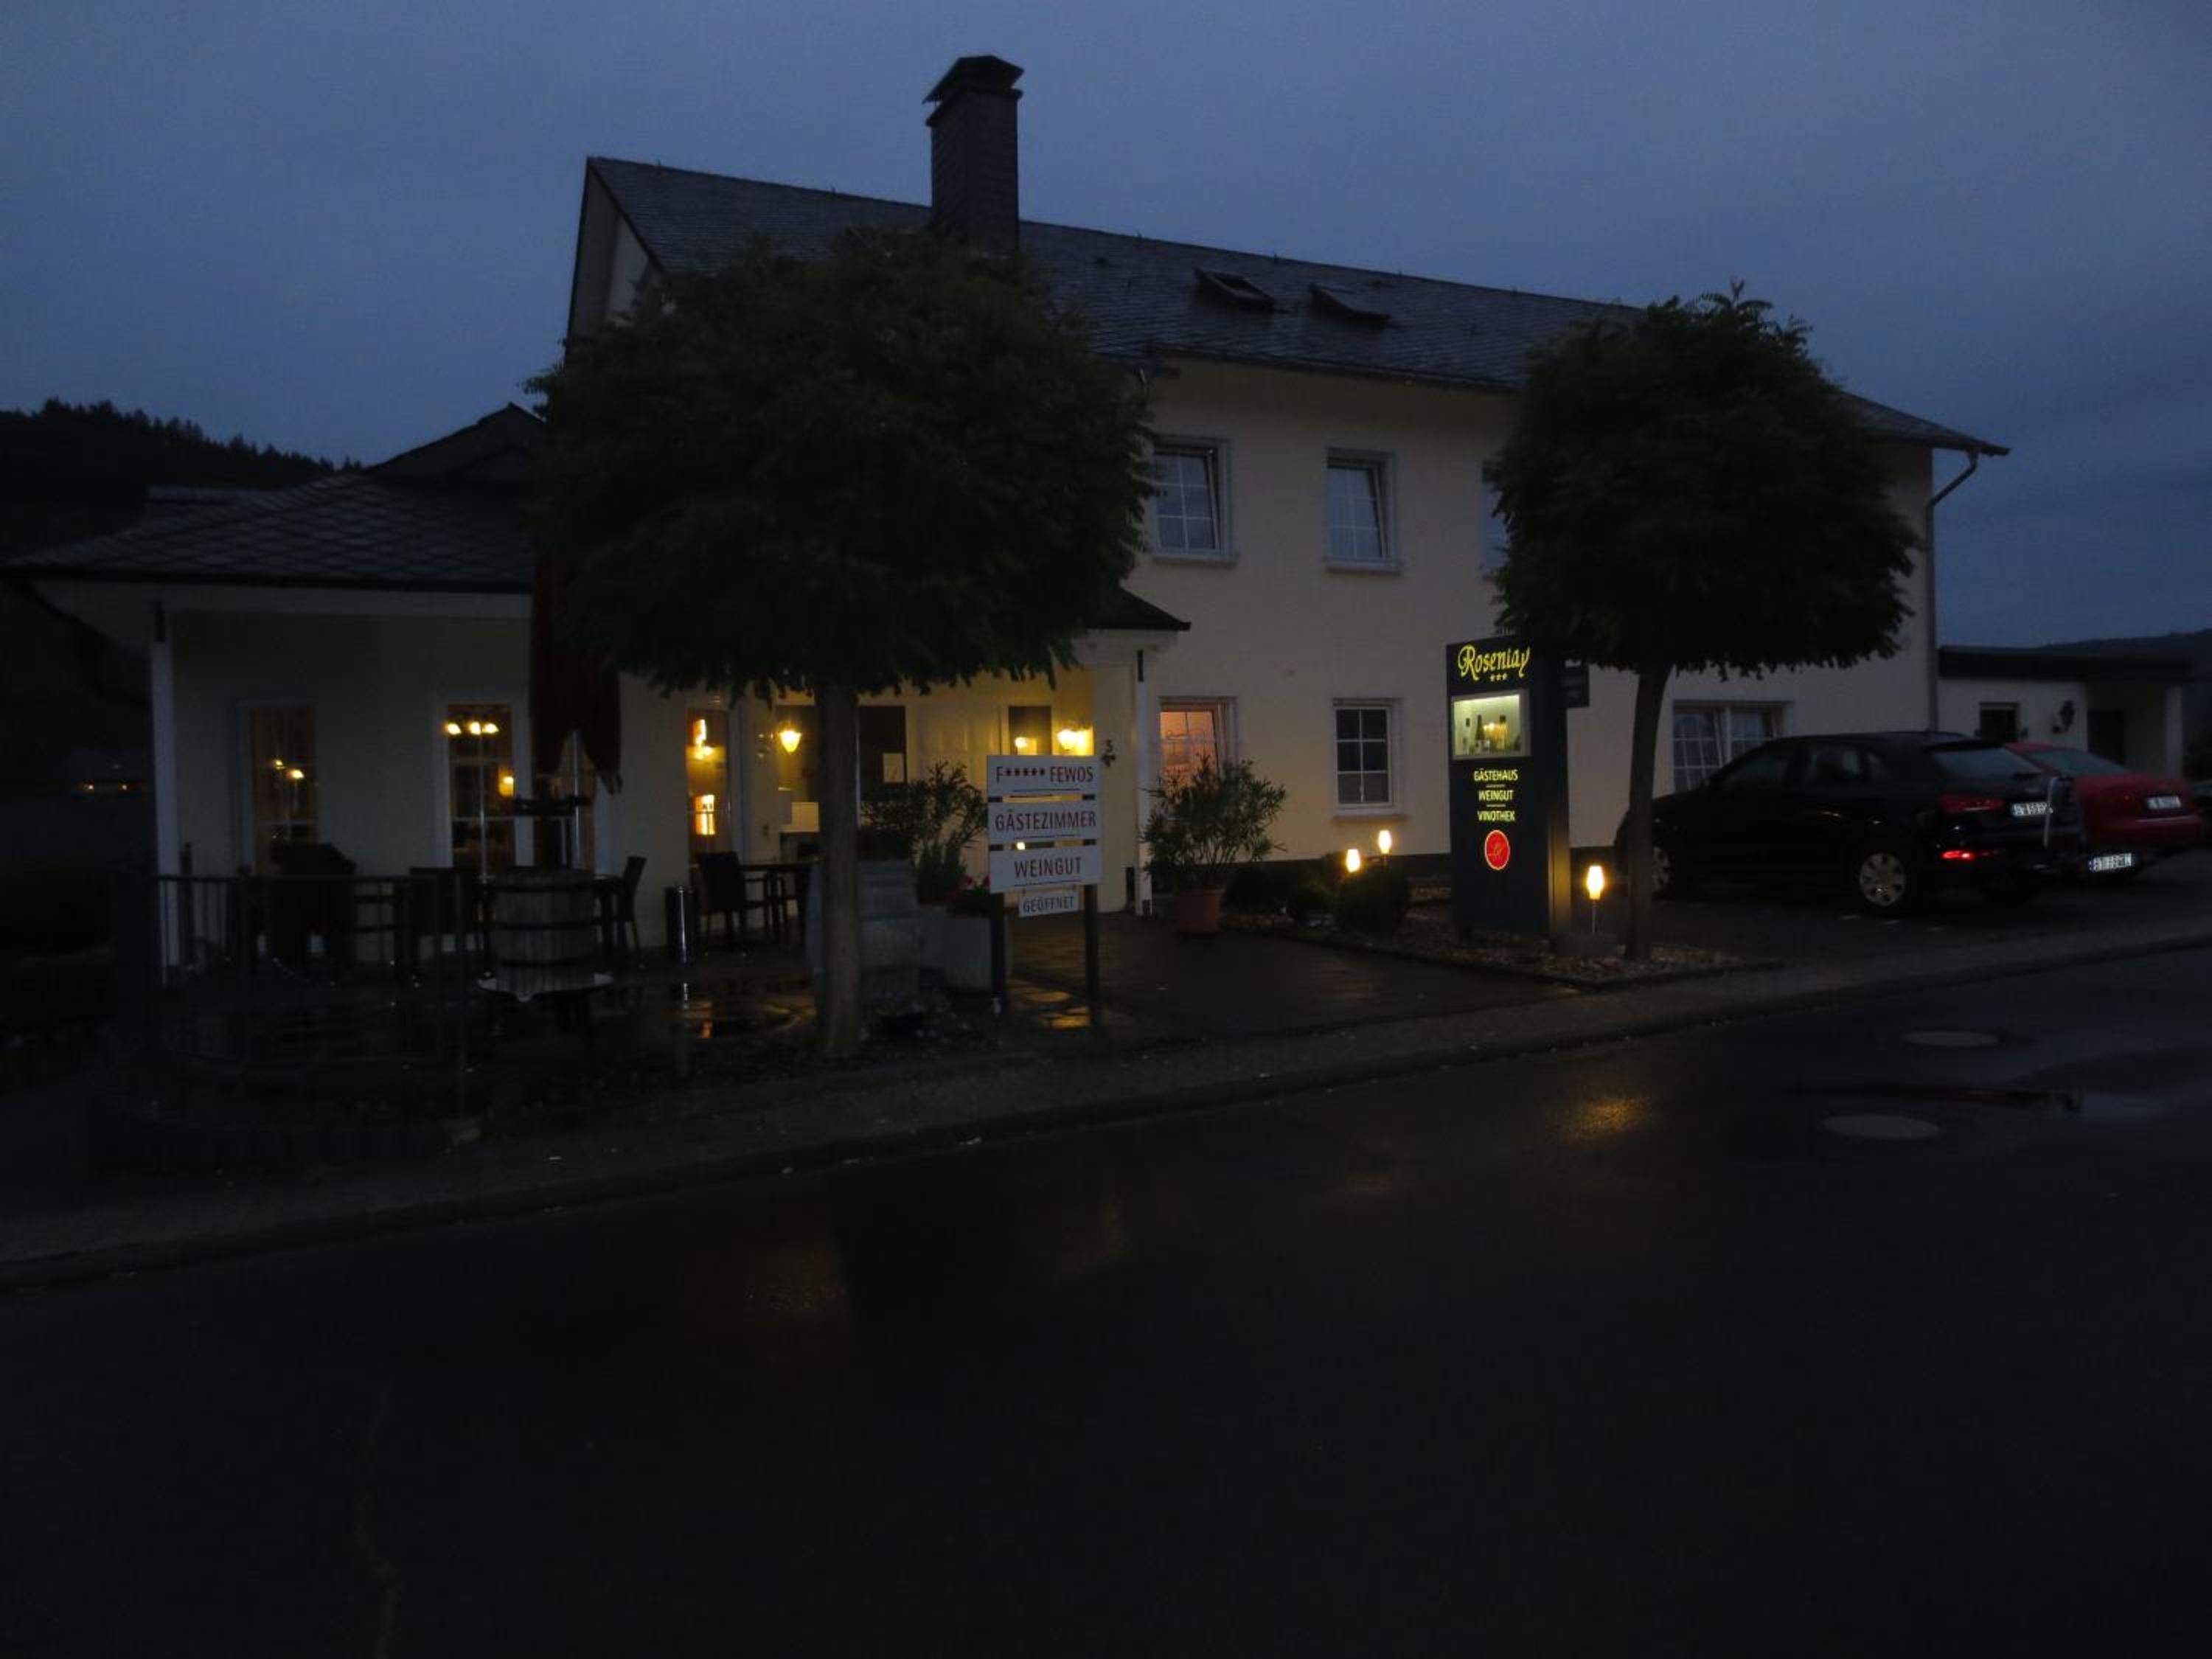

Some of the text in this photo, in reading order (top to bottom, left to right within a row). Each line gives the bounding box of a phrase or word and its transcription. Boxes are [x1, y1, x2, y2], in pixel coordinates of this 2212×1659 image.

[1049, 765, 1093, 783] FEWOS
[1473, 768, 1518, 782] GÄSTEHAUS
[1478, 789, 1514, 801] WEINGUT
[995, 808, 1096, 832] GÄSTEZIMMER
[1477, 810, 1516, 822] VINOTHEK
[1014, 856, 1082, 877] WEINGUT
[1023, 894, 1074, 914] GEÖFFNET
